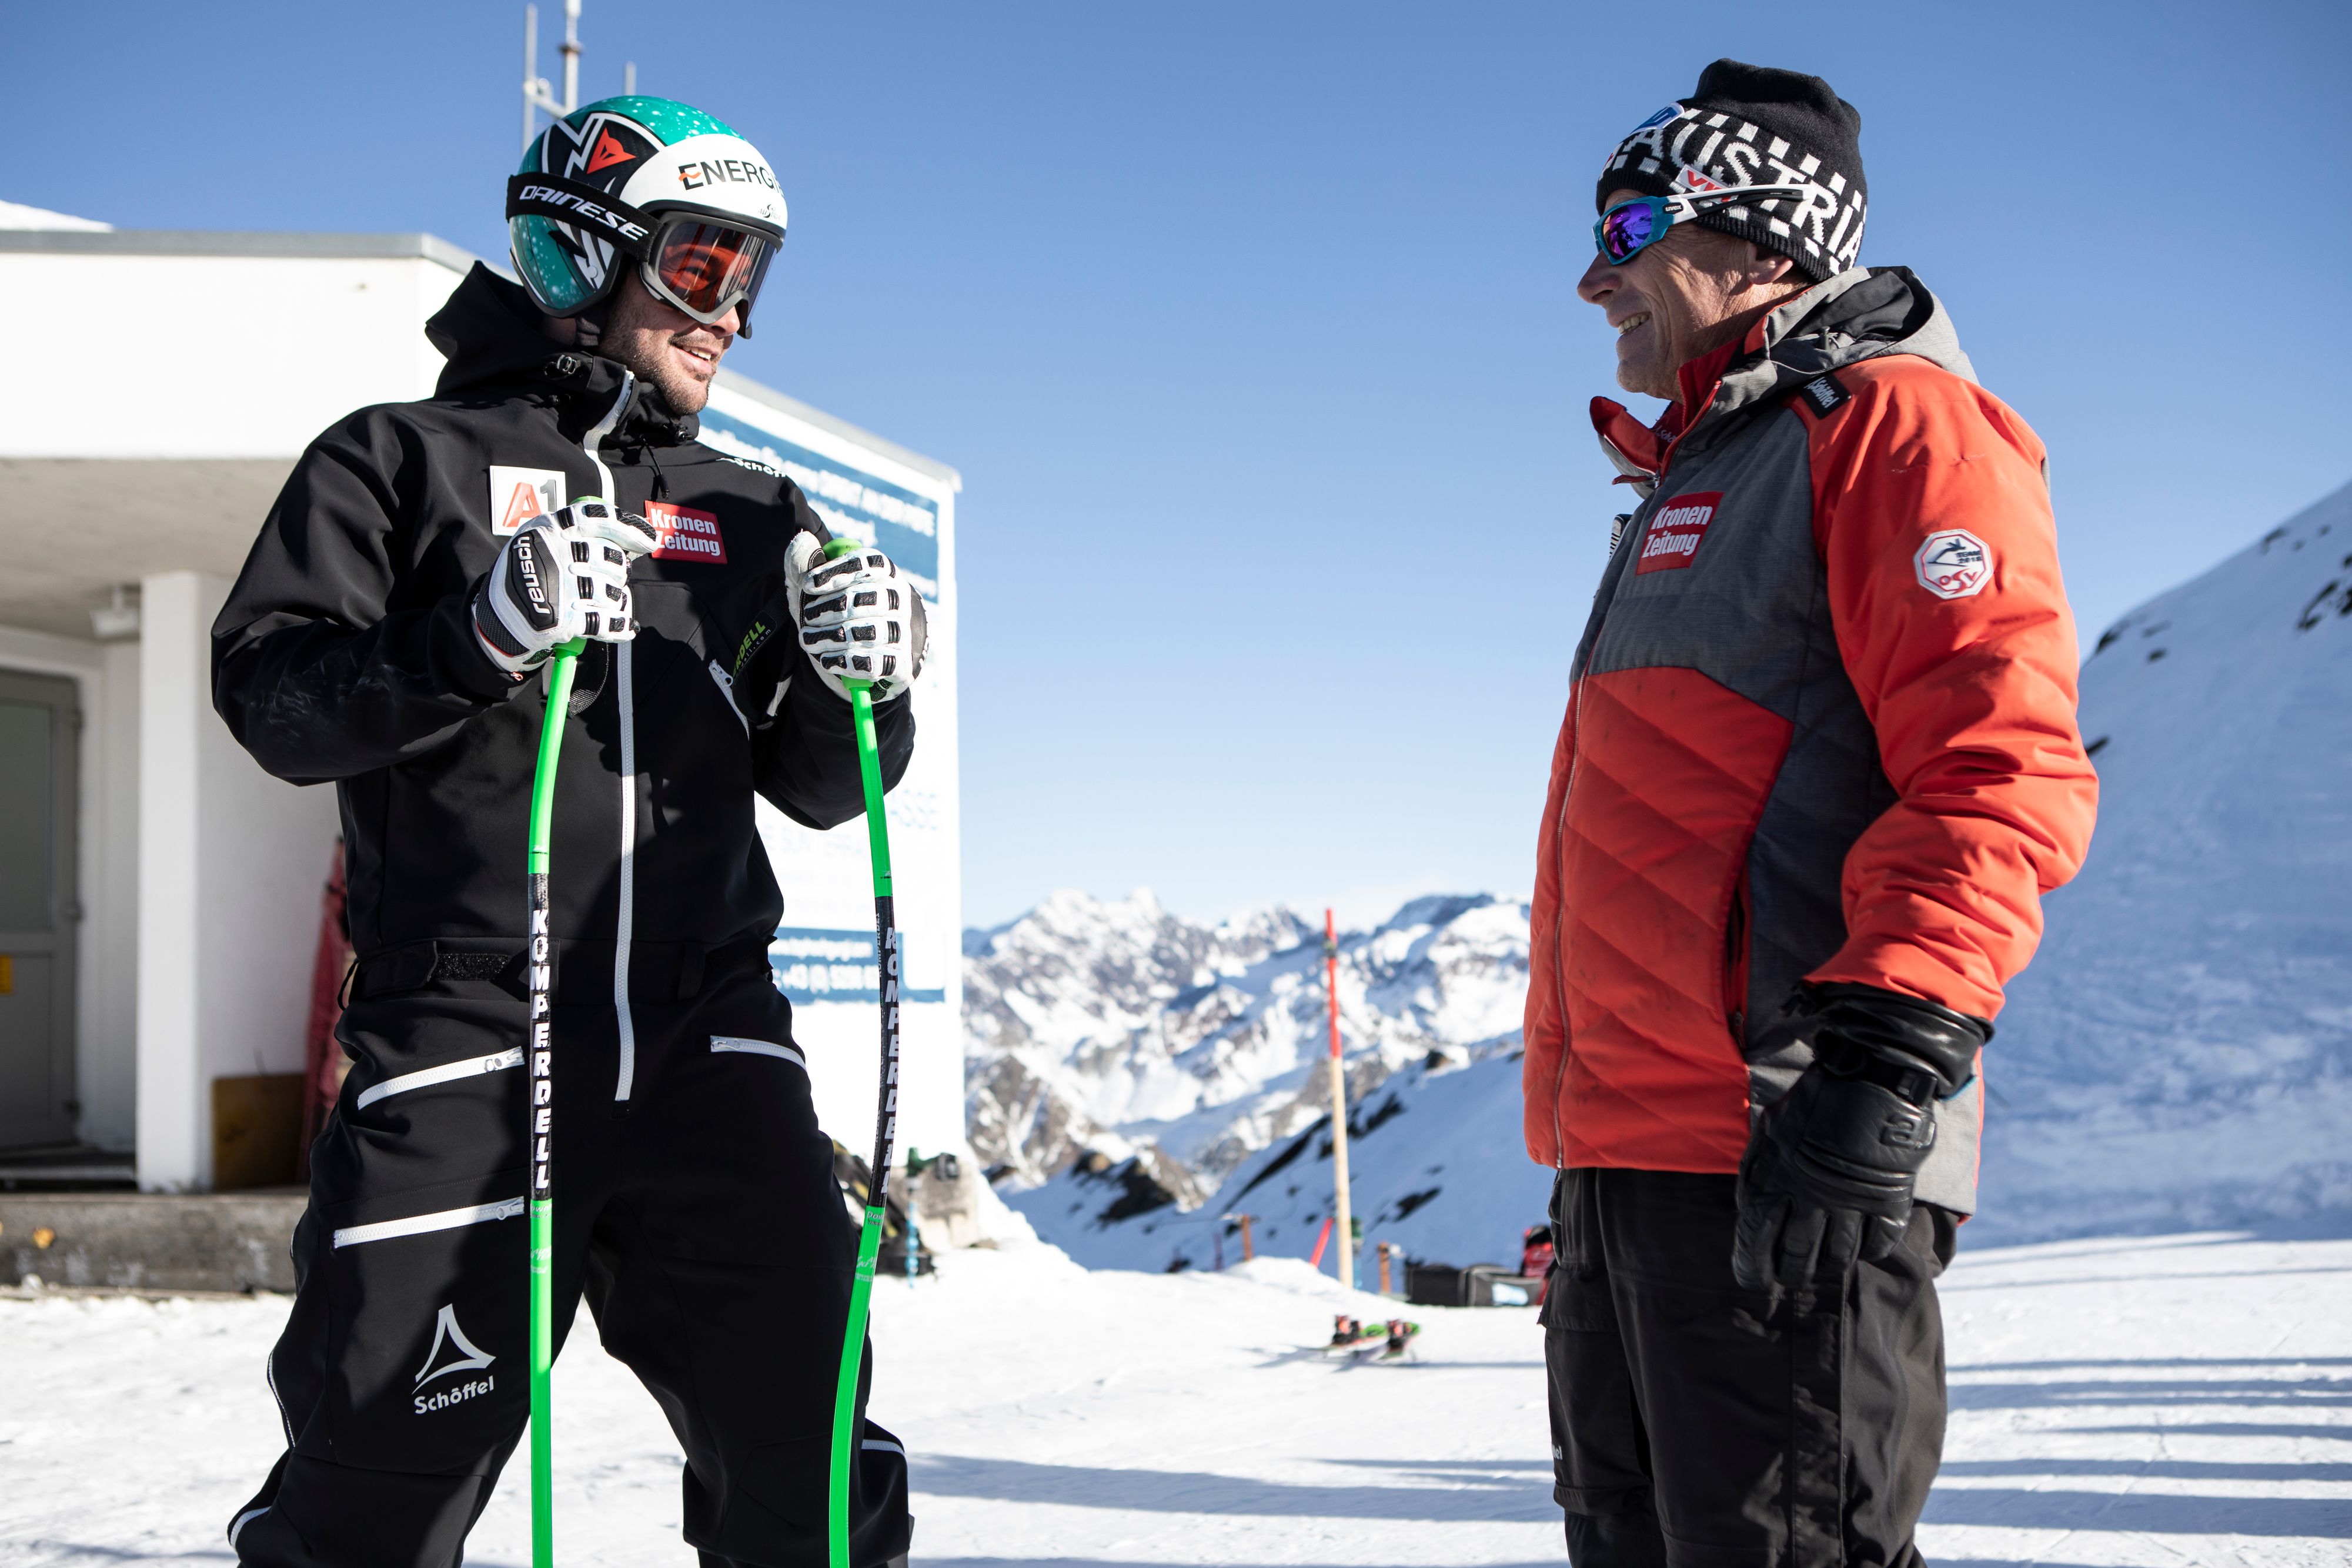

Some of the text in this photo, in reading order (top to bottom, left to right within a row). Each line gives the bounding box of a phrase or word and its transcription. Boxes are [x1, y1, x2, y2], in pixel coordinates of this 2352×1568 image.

[519, 185, 649, 241] DAINESE
[1622, 123, 1864, 269] AUSTRIA
[502, 479, 557, 527] A1
[650, 508, 716, 534] Kronen
[1652, 506, 1713, 530] Kronen
[656, 531, 720, 556] Zeitung
[1642, 530, 1701, 559] Zeitung
[513, 536, 551, 614] reusch
[530, 910, 551, 1189] KOMPERDELL
[414, 1375, 495, 1415] Schöffel
